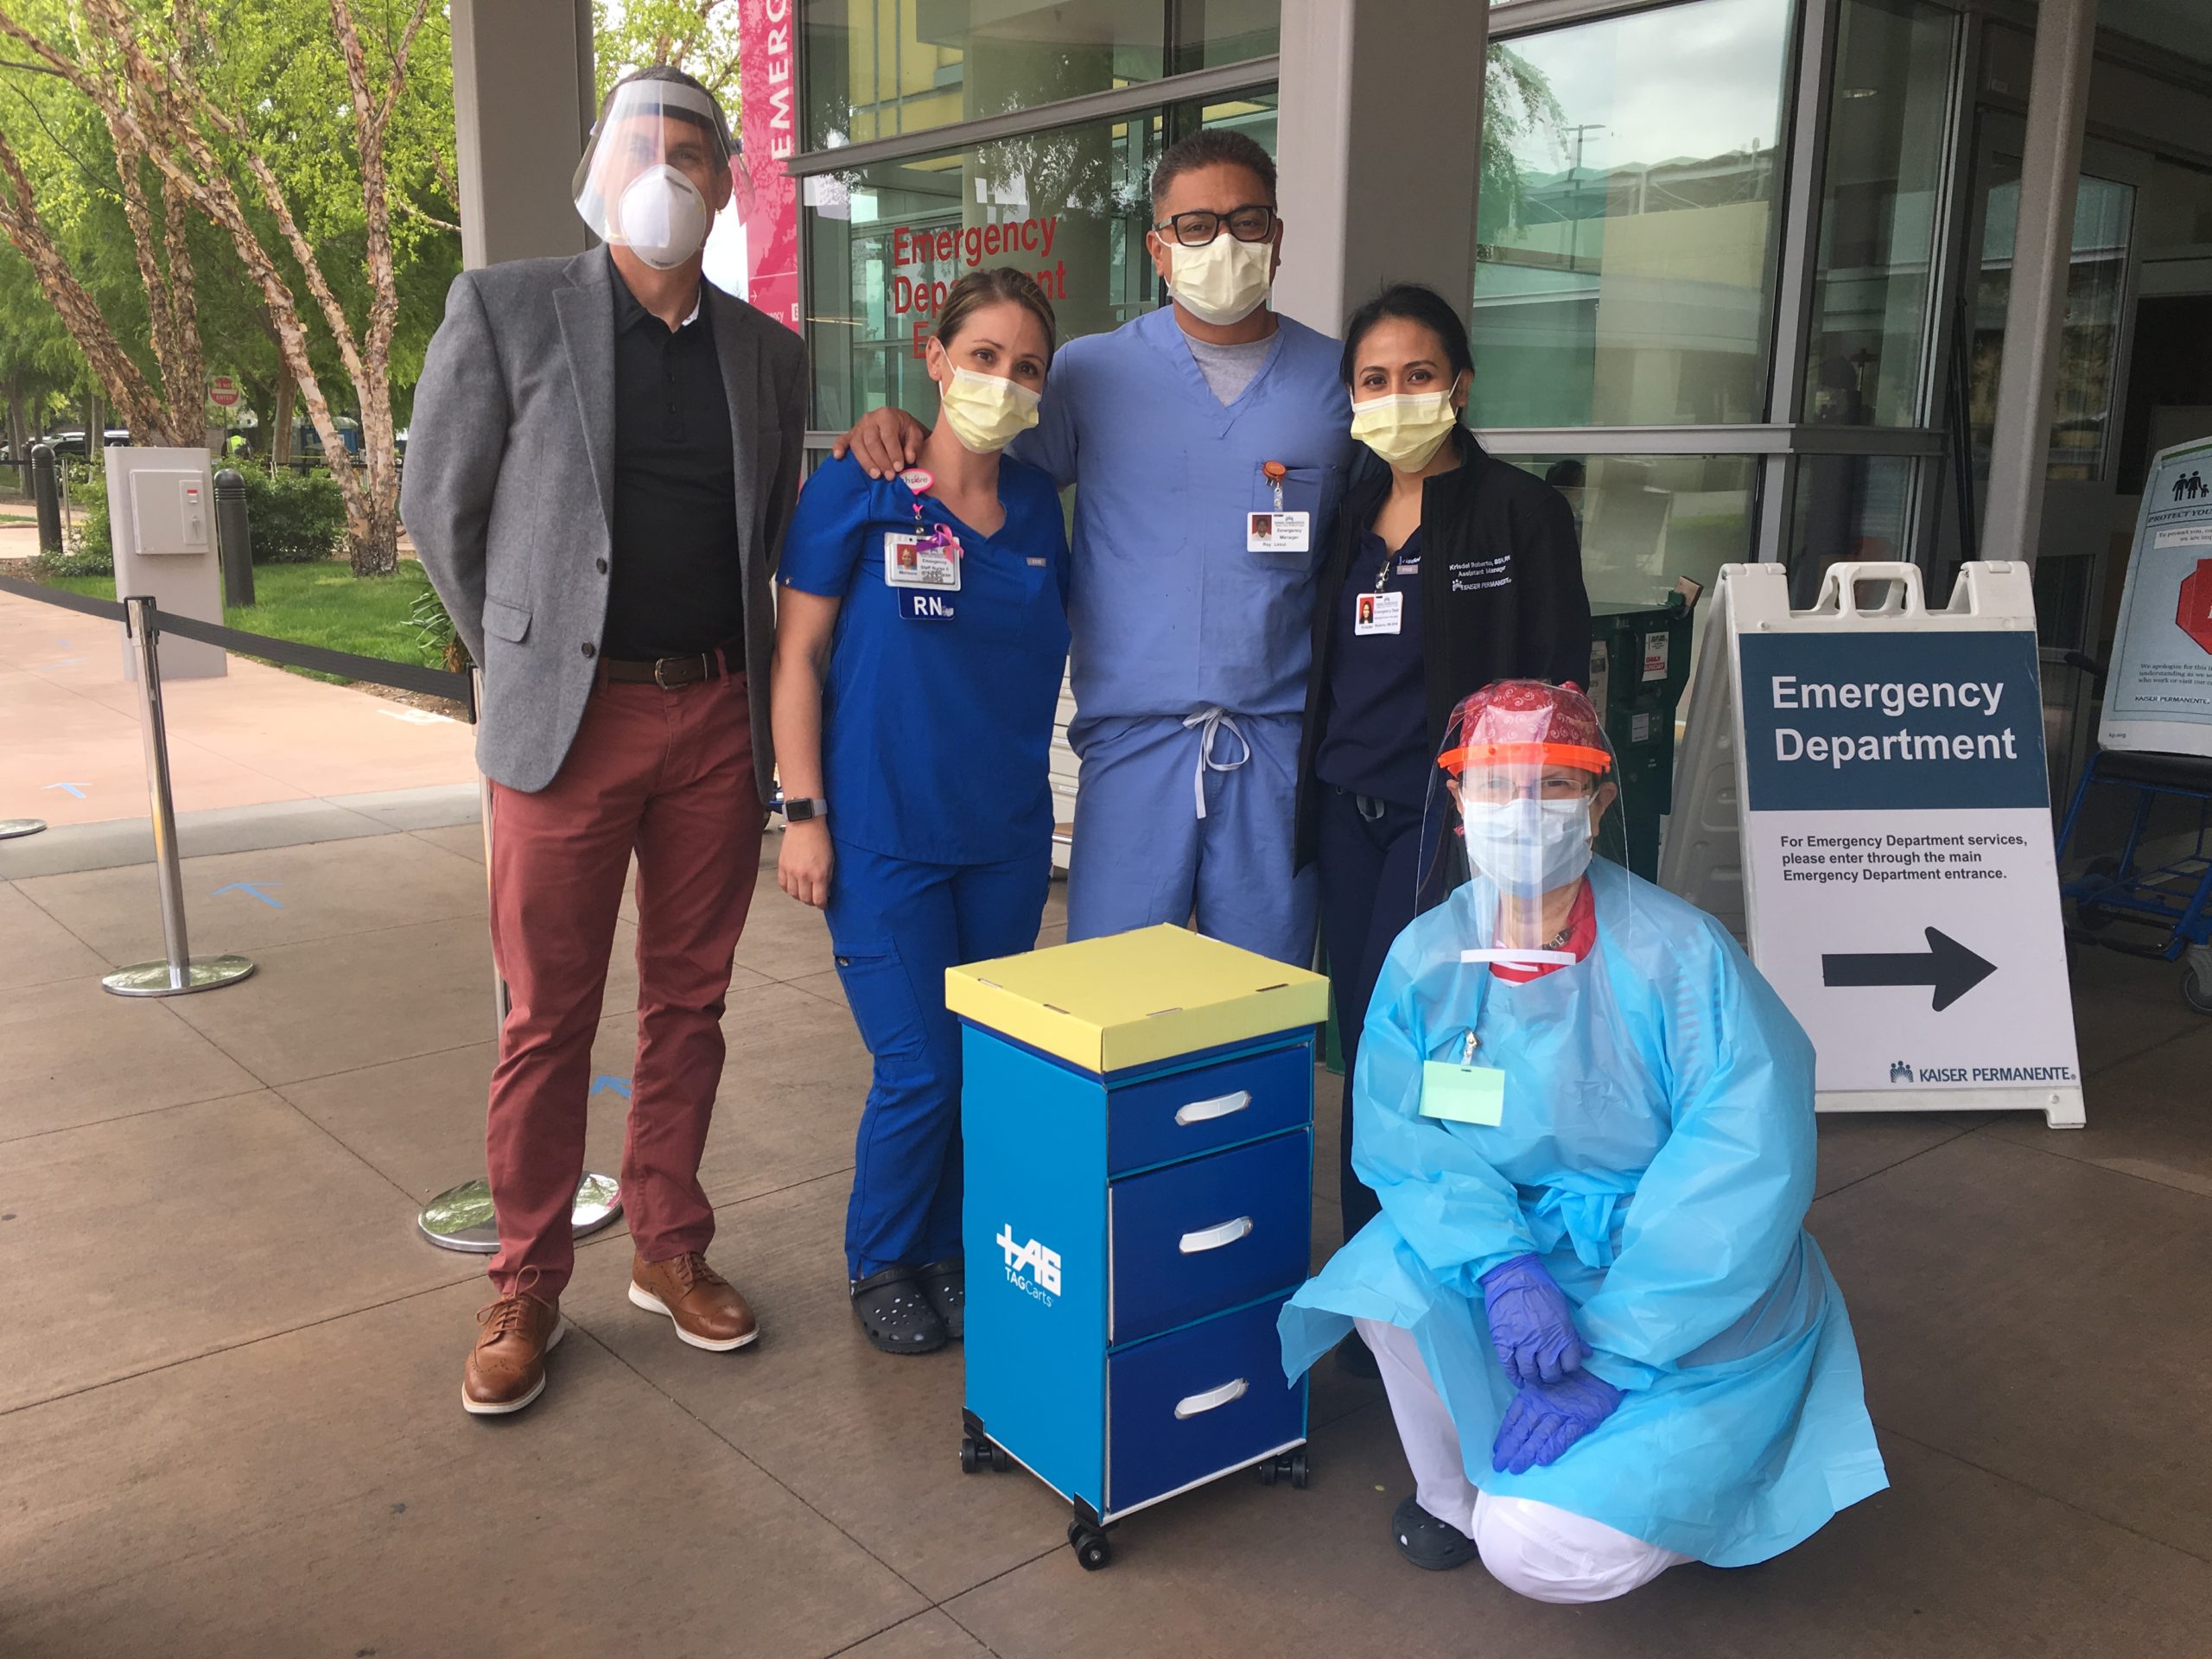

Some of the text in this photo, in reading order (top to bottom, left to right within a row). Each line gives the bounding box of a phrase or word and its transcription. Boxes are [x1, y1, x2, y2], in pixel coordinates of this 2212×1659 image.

[893, 216, 1058, 267] Emergency
[2148, 511, 2190, 523] PROTECT
[1458, 569, 1484, 577] Assistant
[913, 595, 943, 616] RN
[1771, 676, 2005, 716] Emergency
[1775, 728, 2018, 769] Department
[1781, 833, 2027, 849] For Emergency Department services,
[1783, 850, 1982, 867] please enter through the main
[1783, 868, 2006, 883] Emergency Department entrance.
[1919, 1068, 1968, 1082] KAISER
